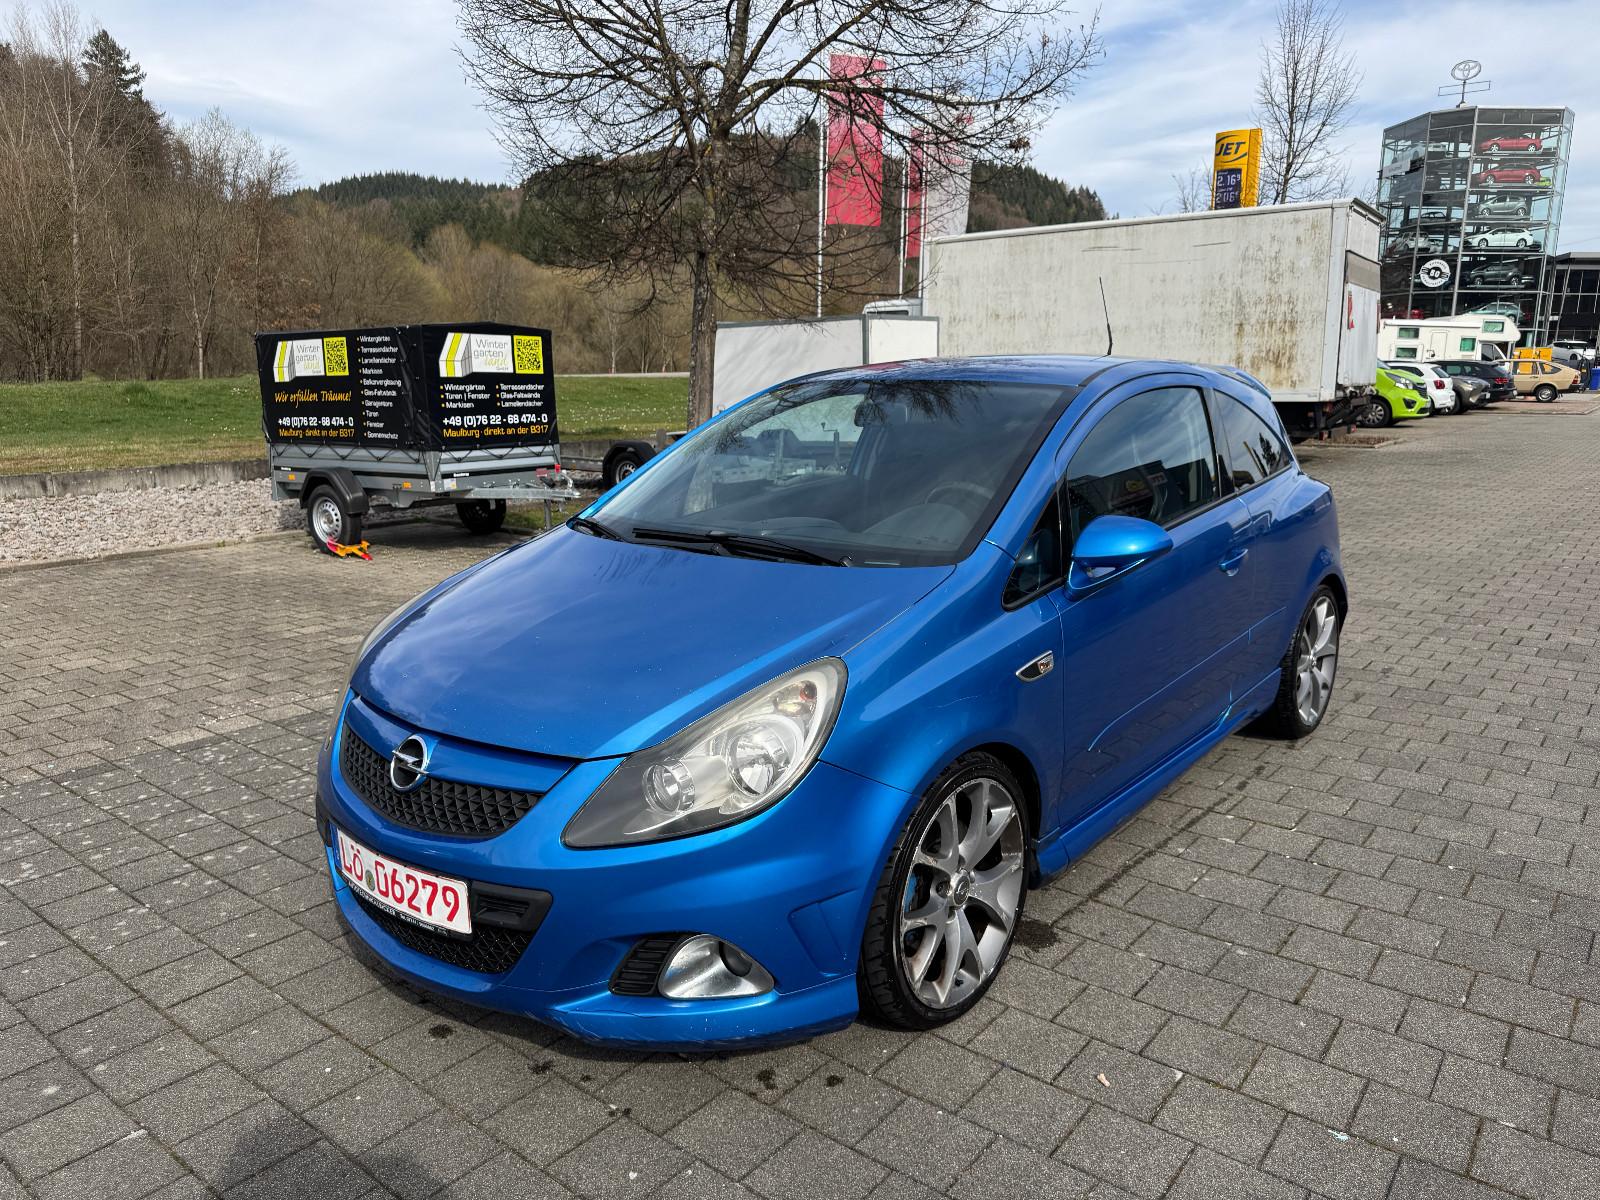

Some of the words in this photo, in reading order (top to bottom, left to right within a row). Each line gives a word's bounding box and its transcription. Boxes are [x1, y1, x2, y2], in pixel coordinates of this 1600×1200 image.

[1215, 141, 1246, 157] JET
[475, 338, 508, 349] Winter
[296, 345, 320, 353] Winter
[474, 349, 504, 359] garten
[295, 354, 318, 364] garten
[444, 383, 486, 392] Wintergärten
[275, 391, 289, 402] Wir
[289, 388, 318, 409] erfüllen
[320, 390, 352, 402] Träume!
[467, 392, 491, 400] Fenster
[446, 401, 475, 409] Markisen
[278, 417, 290, 426] +49
[308, 416, 318, 426] 22
[331, 416, 344, 426] 474
[348, 416, 354, 426] 0
[443, 416, 462, 426] +49
[464, 415, 488, 428] (0)76
[489, 414, 502, 425] 22
[507, 414, 520, 424] 68
[520, 413, 537, 423] 474
[541, 413, 548, 423] 0
[443, 427, 480, 438] Maulburg
[484, 426, 505, 436] direkt
[506, 427, 516, 435] an
[517, 425, 529, 434] der
[530, 424, 549, 434] B317
[340, 836, 364, 881] LÖ
[375, 860, 460, 922] 06279
